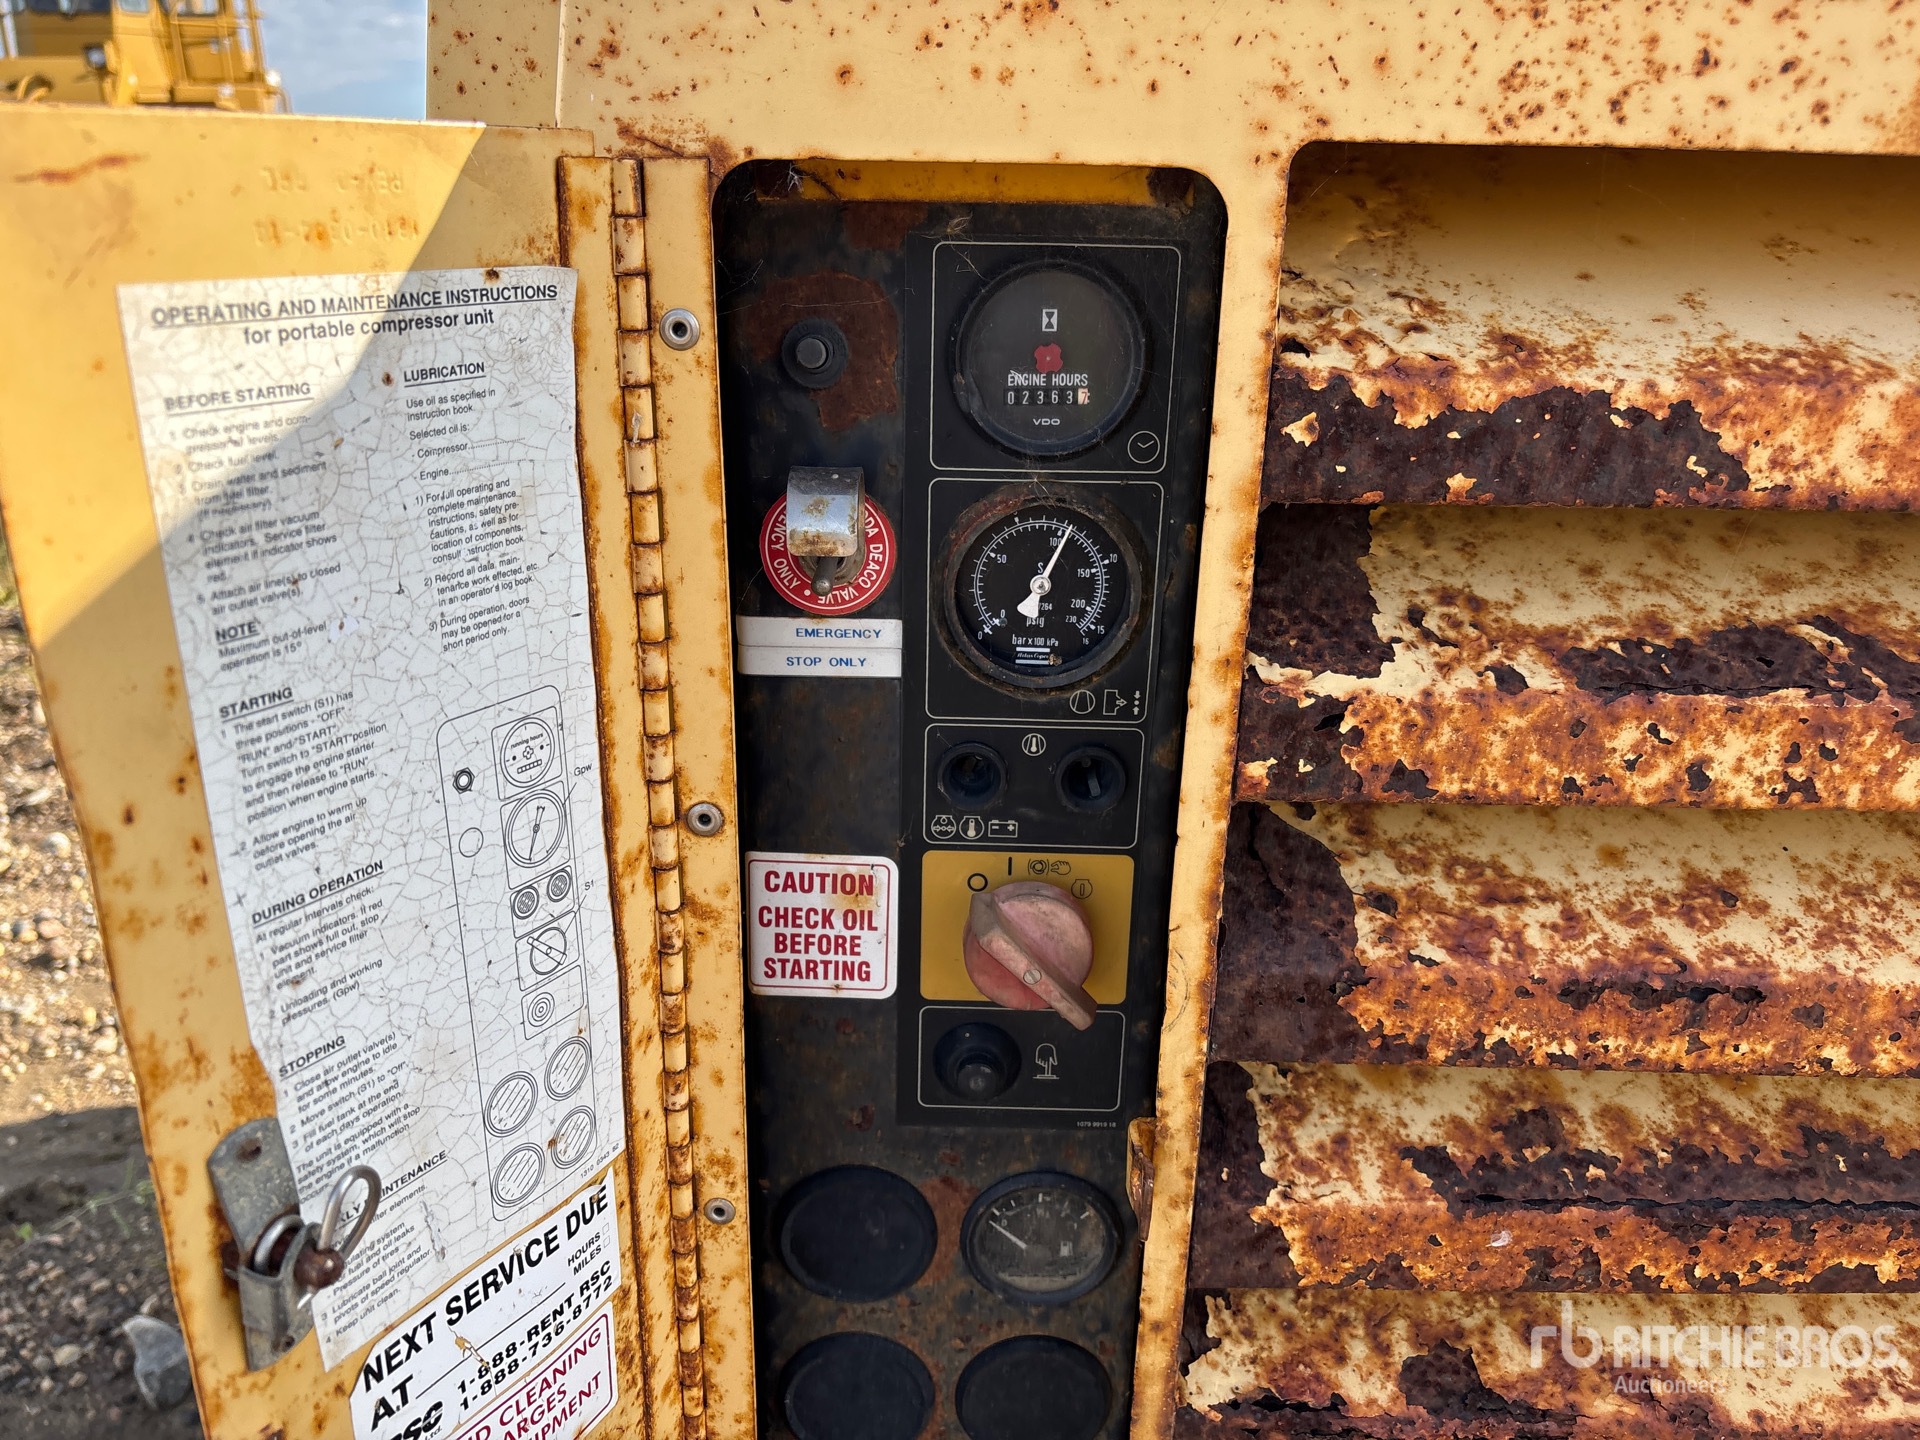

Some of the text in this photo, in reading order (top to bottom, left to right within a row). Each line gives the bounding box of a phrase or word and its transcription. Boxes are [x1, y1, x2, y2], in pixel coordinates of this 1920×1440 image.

[152, 285, 557, 324] OPERATING AND MAINTENANCE INSTRUCTIONS
[244, 309, 494, 346] for portable compressor unit
[404, 362, 485, 382] LUBRICATION
[1008, 374, 1088, 386] ENGINE HOURS
[164, 383, 310, 410] BEFORE STARTING
[406, 399, 423, 408] Use
[426, 396, 435, 405] oil
[450, 389, 486, 403] specified
[489, 389, 495, 397] in
[407, 408, 450, 421] instruction
[409, 426, 446, 440] Selected
[460, 423, 469, 432] is:
[428, 491, 516, 515] complete maintenance
[429, 503, 519, 527] instructions, safety pre-
[430, 524, 466, 540] cautions,
[481, 518, 495, 528] well
[498, 515, 507, 524] as
[509, 513, 518, 521] for
[431, 538, 463, 552] location
[465, 534, 473, 543] of
[859, 544, 883, 588] DEACO
[997, 554, 1006, 563] 50
[1038, 563, 1043, 573] S
[1110, 554, 1117, 562] 10
[438, 580, 469, 596] tenance
[472, 574, 490, 586] work
[774, 559, 801, 589] ONLY
[1078, 569, 1090, 577] 150
[818, 587, 859, 604] VALVE
[1071, 599, 1085, 608] 200
[429, 596, 529, 631] 3) During operation, doors
[1000, 610, 1005, 618] 0
[1026, 617, 1044, 627] psig
[218, 622, 327, 658] Maximum out-of-level
[796, 628, 882, 639] EMERGENCY
[1012, 634, 1026, 644] bar
[1047, 638, 1058, 646] kPa
[1097, 626, 1104, 634] 15
[787, 657, 866, 667] STOP ONLY
[219, 687, 292, 719] STARTING
[234, 691, 353, 734] The start switch (S1) has
[511, 733, 543, 749] running hours
[574, 763, 592, 776] Gpw
[253, 797, 367, 846] Allow engine to warm up
[252, 860, 383, 924] DURING OPERATION
[585, 879, 594, 890] S1
[765, 870, 873, 896] CAUTION
[256, 887, 374, 944] At regular intervals check:
[759, 906, 878, 931] CHECK OIL
[775, 933, 861, 956] BEFORE
[764, 958, 870, 981] STARTING
[280, 959, 383, 1013] Unloading and working
[279, 1036, 345, 1077] STOPPING
[294, 1032, 396, 1092] Close air outlet valve(s)
[303, 1083, 399, 1143] Fill fuel tank at the end
[380, 1150, 446, 1197] INTENANCE
[581, 1164, 594, 1178] 1310
[568, 1232, 600, 1266] HOURS
[573, 1245, 601, 1276] MILES
[332, 1245, 421, 1314] Lubricate ball joint and
[363, 1184, 608, 1392] NEXT SERVICE DUE
[336, 1289, 400, 1336] Keep unit clean.
[458, 1260, 610, 1394] 1-888-RENT RSC
[460, 1276, 612, 1411] 1-888-736-8772
[499, 1328, 601, 1426] CLEANING
